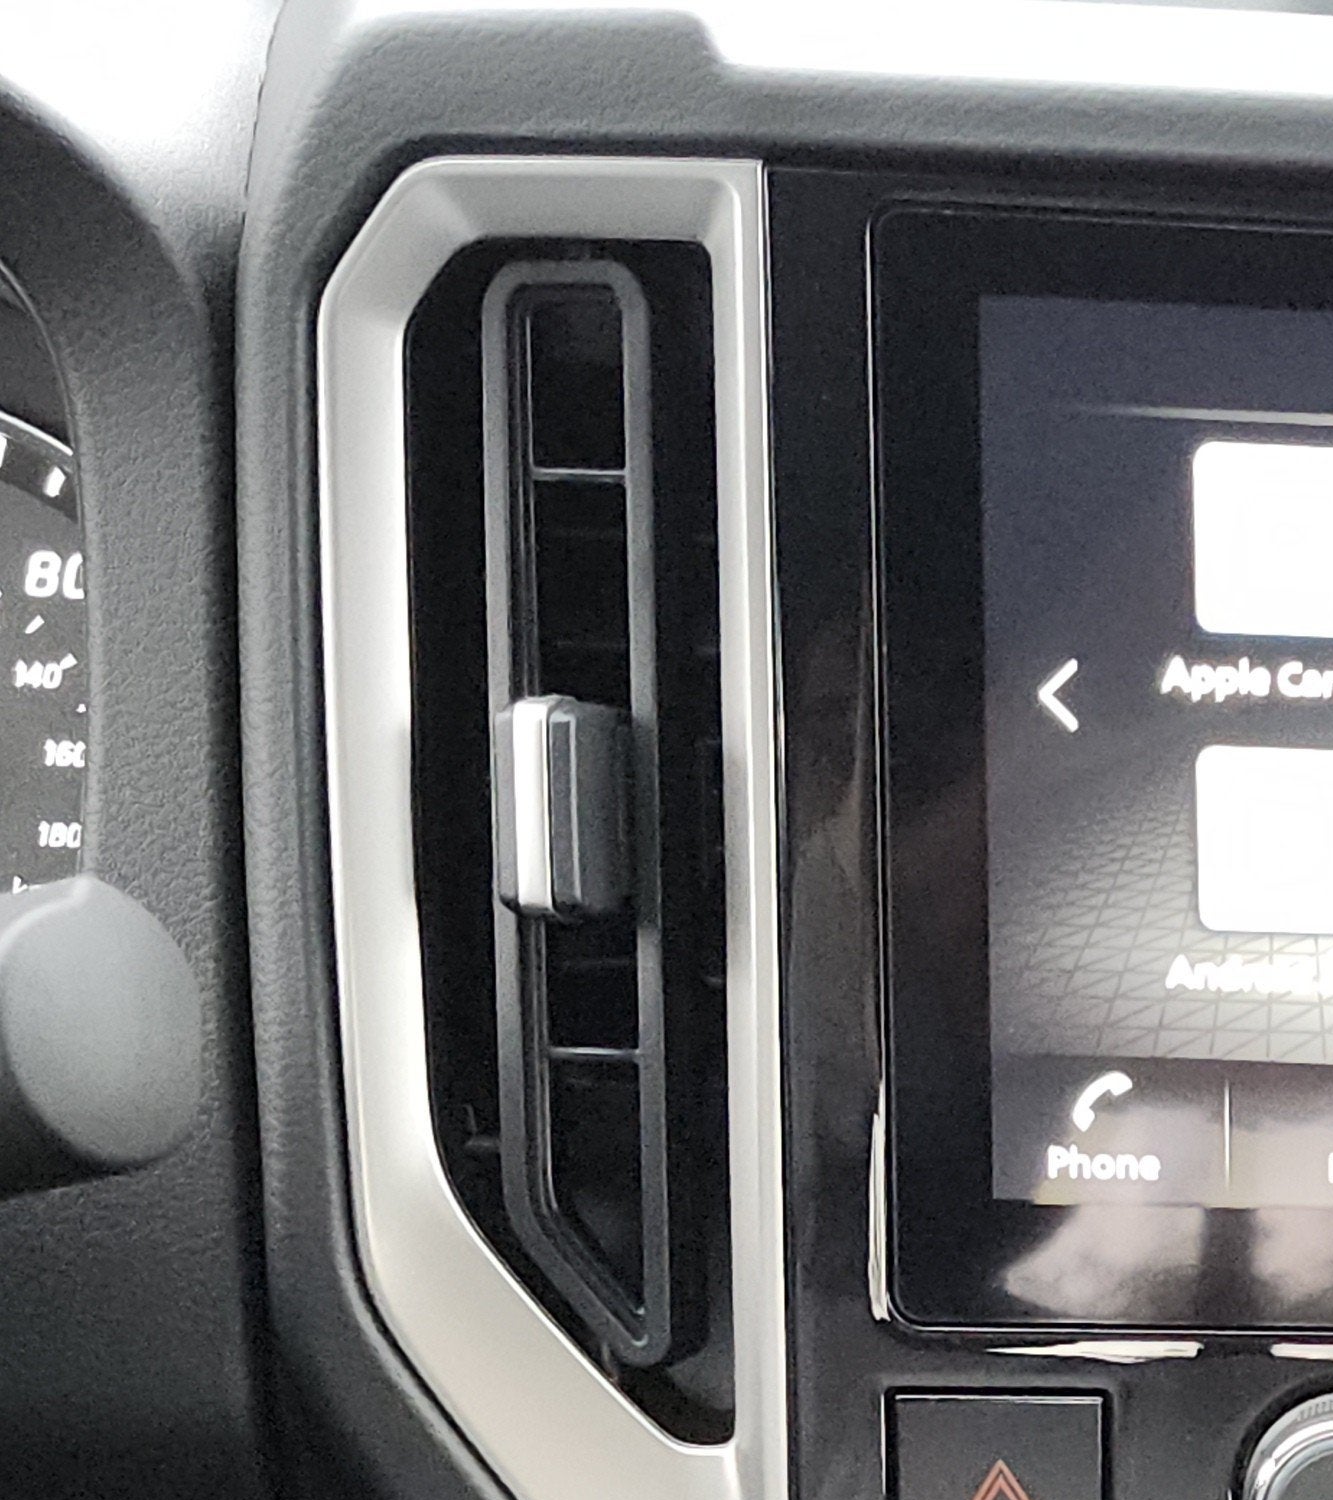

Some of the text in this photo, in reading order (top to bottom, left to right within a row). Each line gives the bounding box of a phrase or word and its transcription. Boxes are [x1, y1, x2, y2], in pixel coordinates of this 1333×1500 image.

[12, 660, 64, 691] 140
[1161, 656, 1273, 704] Apple
[1049, 1145, 1162, 1182] Phone
